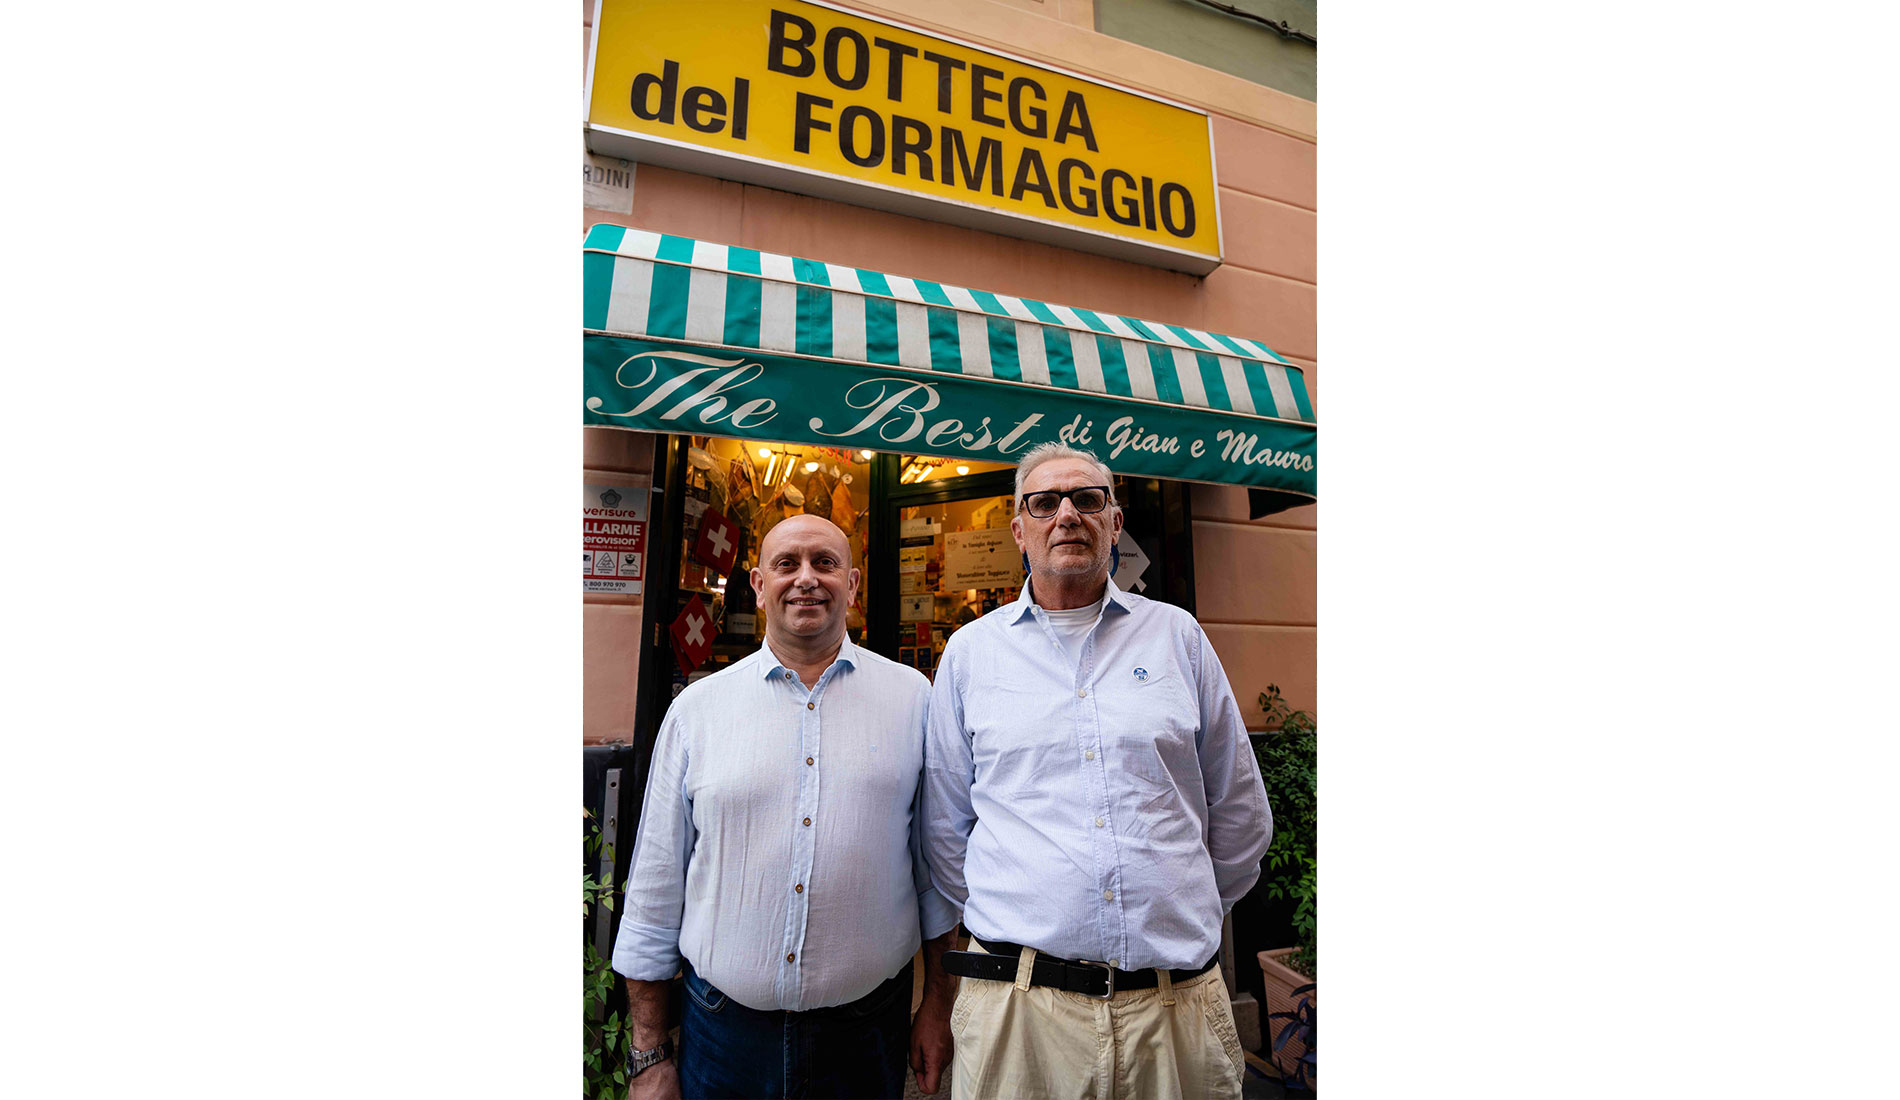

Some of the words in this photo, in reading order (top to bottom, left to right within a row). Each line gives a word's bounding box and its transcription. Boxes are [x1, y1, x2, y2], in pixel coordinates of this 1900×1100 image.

[630, 59, 750, 141] del
[794, 91, 1196, 239] FORMAGGIO
[767, 8, 1099, 153] BOTTEGA
[586, 350, 779, 429] The
[809, 377, 1045, 455] Best
[1058, 413, 1093, 445] di
[1105, 416, 1180, 460] Gian
[1190, 439, 1206, 458] e
[1216, 428, 1314, 472] Mauro
